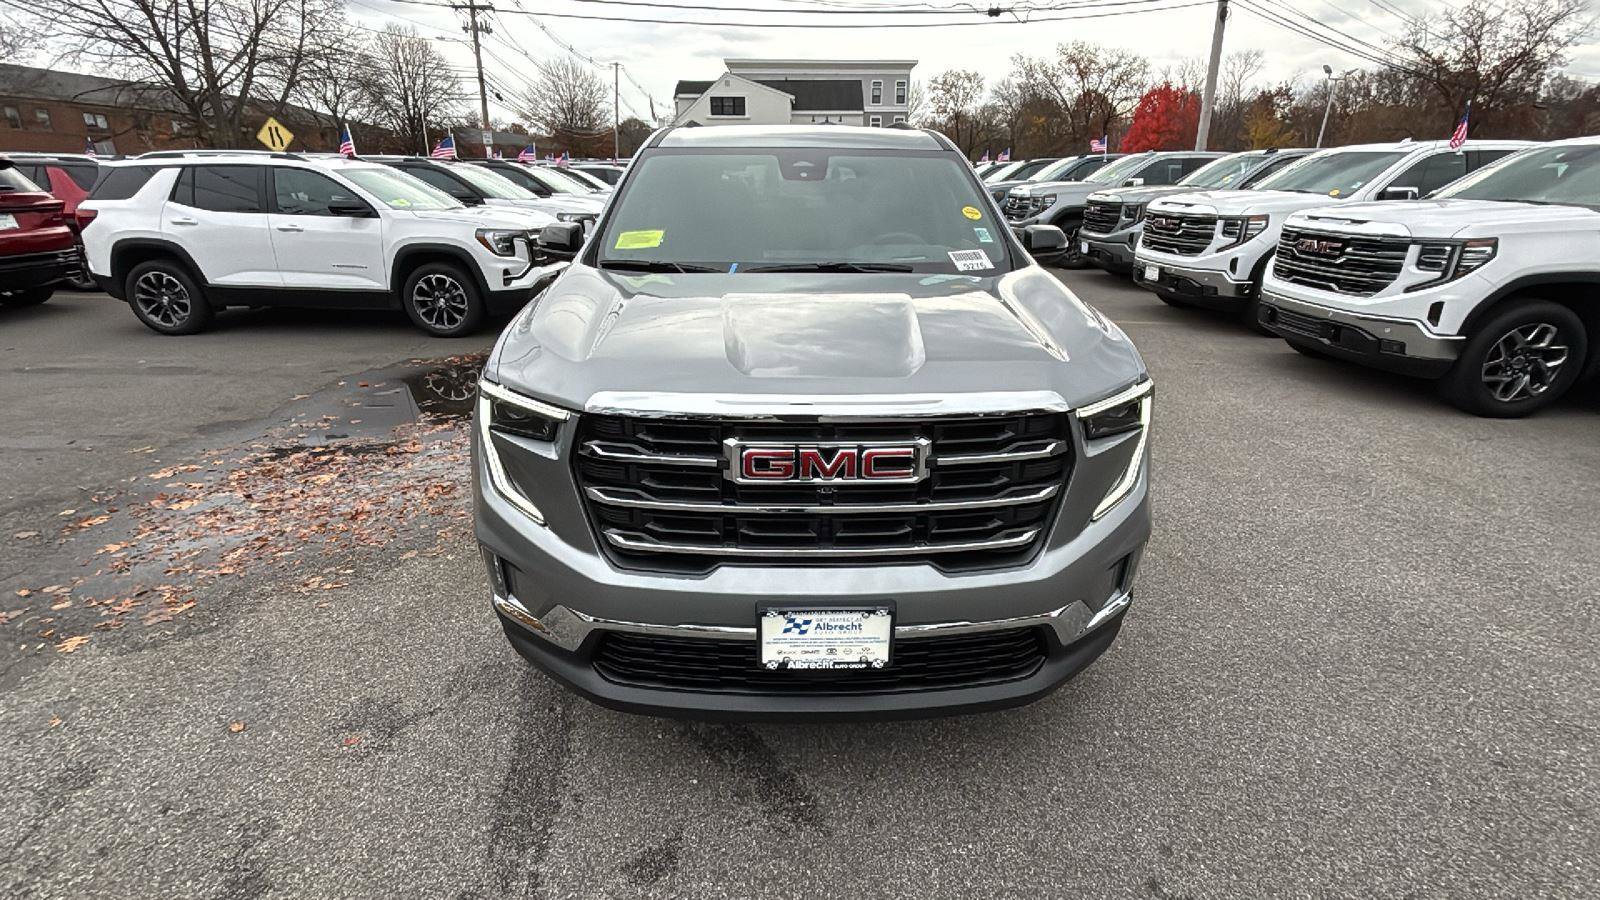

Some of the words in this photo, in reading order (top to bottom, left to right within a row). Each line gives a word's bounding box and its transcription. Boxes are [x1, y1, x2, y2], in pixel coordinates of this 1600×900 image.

[1296, 238, 1343, 256] GMC
[743, 448, 915, 480] GMC
[814, 622, 863, 631] Albrecht
[787, 660, 834, 669] Albrecht
